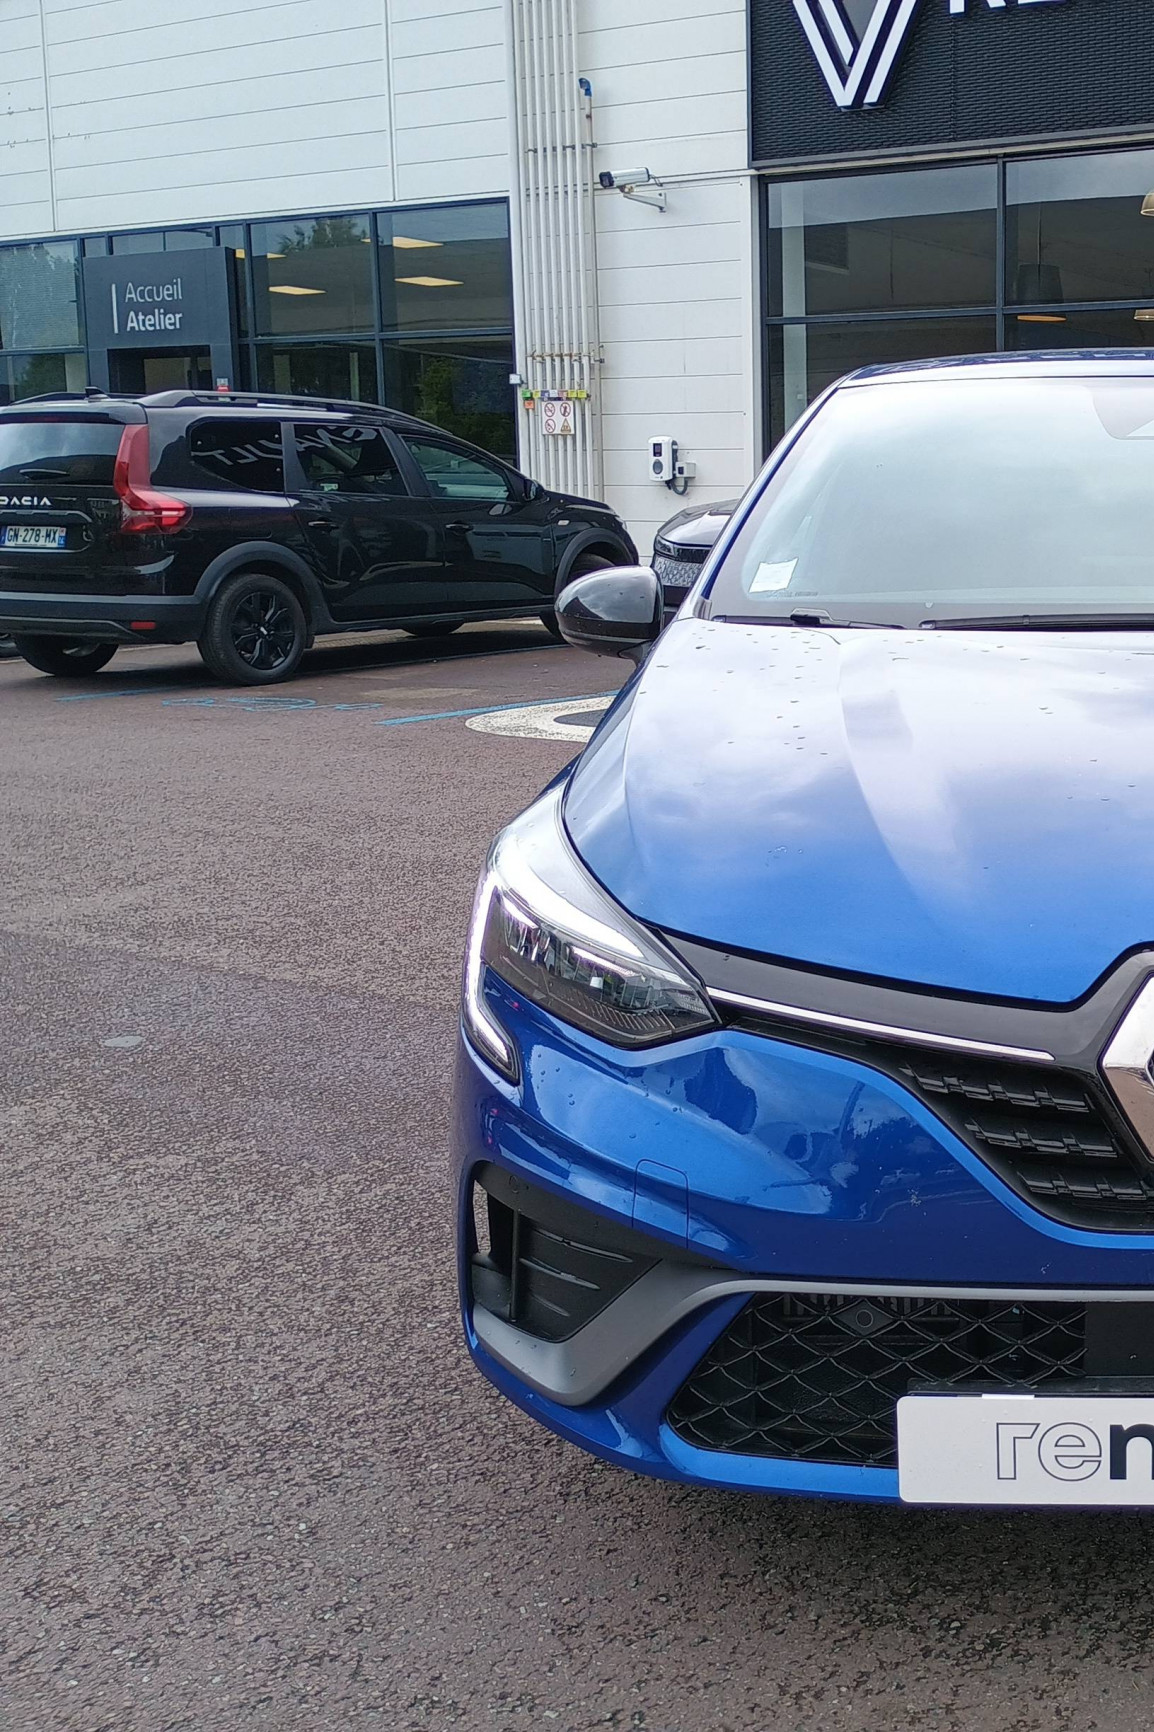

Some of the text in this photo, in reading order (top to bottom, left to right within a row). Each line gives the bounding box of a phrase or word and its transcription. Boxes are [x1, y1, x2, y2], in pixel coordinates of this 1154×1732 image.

[125, 278, 182, 302] Accueil
[127, 308, 182, 331] Atelier
[0, 496, 52, 506] DACIA
